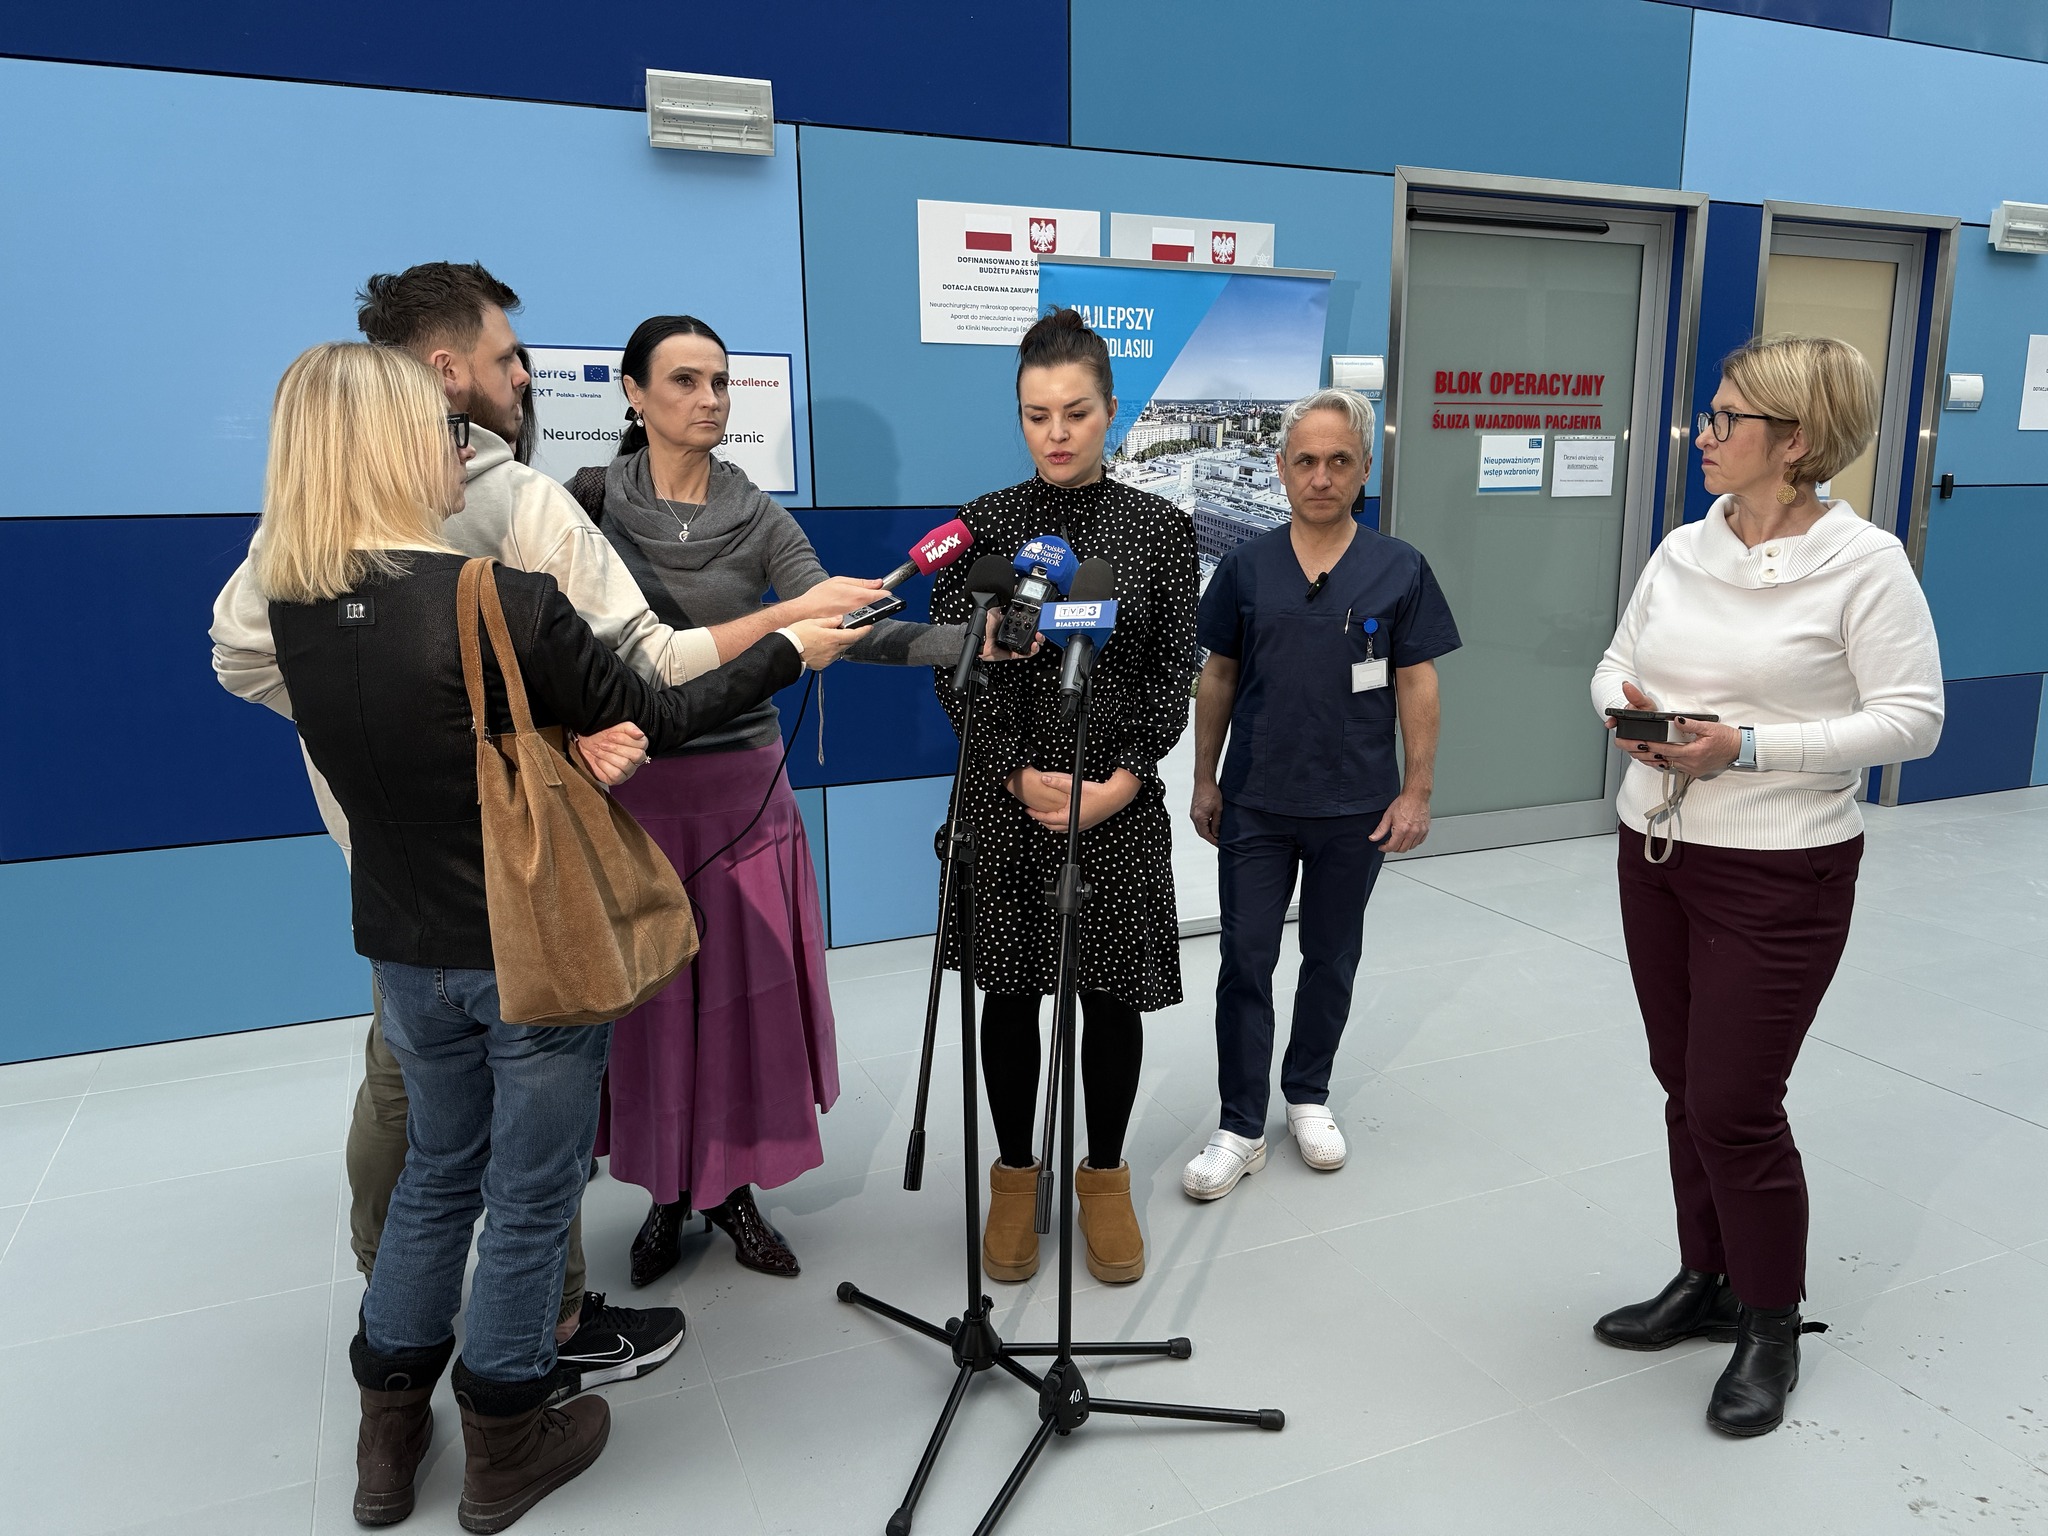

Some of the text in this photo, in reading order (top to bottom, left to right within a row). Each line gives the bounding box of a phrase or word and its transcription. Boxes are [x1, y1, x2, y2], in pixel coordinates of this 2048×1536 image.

[957, 256, 1020, 266] DOFINANSOWANO
[1021, 259, 1029, 267] ZE
[979, 266, 1009, 275] BUDŻETU
[929, 302, 979, 310] Neurochirurgiczny
[980, 303, 1008, 311] mikroskop
[950, 313, 970, 321] Aparat
[1071, 305, 1154, 330] NAJLEPSZY
[981, 325, 1019, 333] Neurochirurgii
[532, 369, 577, 381] terreg
[1435, 371, 1605, 396] BLOK OPERACYJNY
[1432, 409, 1601, 430] ŚLUZA WJAZDOWA PACJENTA
[1484, 456, 1540, 465] Nieupoważnionym
[1484, 467, 1539, 477] wstęp wzbroniony
[920, 539, 935, 553] RMF
[925, 532, 961, 563] MAXX
[1043, 543, 1066, 554] Polskie
[1020, 550, 1060, 567] Białystok
[1040, 549, 1063, 561] Radio
[1056, 620, 1096, 628] BIAŁYSTOK
